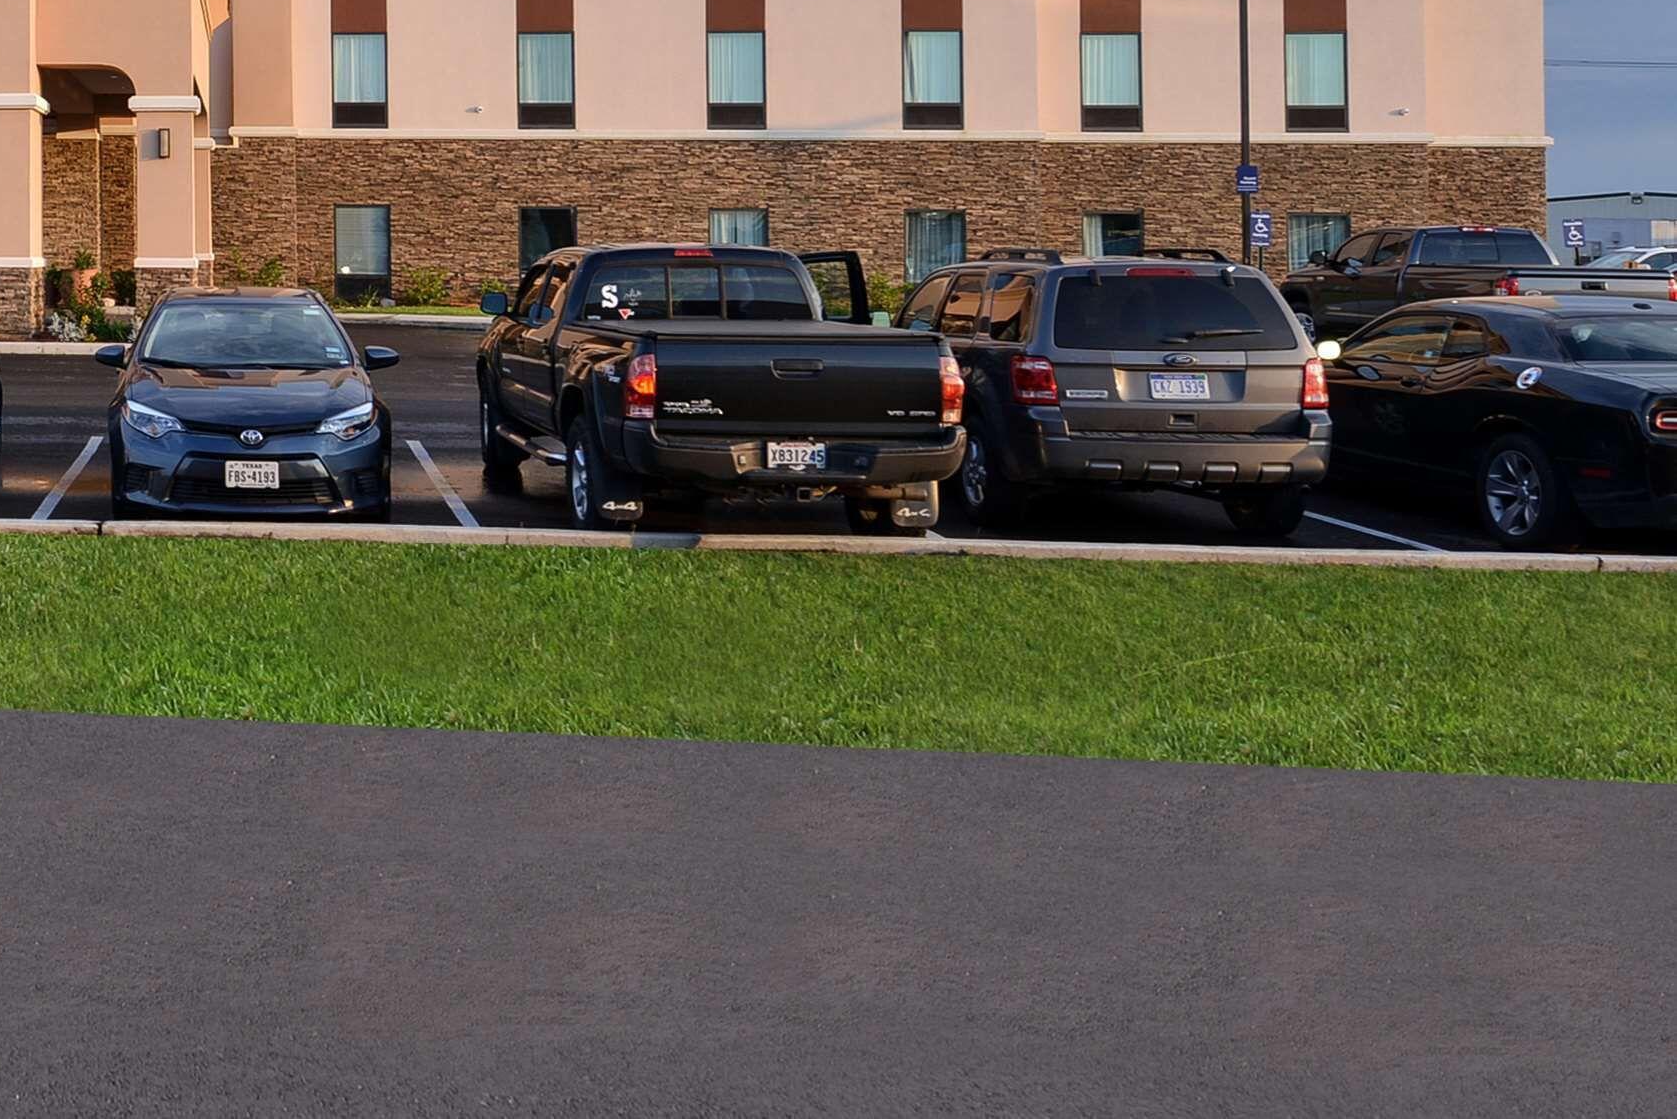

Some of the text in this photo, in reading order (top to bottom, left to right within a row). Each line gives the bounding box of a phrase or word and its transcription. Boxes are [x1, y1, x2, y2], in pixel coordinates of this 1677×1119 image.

[601, 283, 619, 309] S
[1179, 380, 1206, 394] 1939
[662, 407, 724, 416] TACOMA
